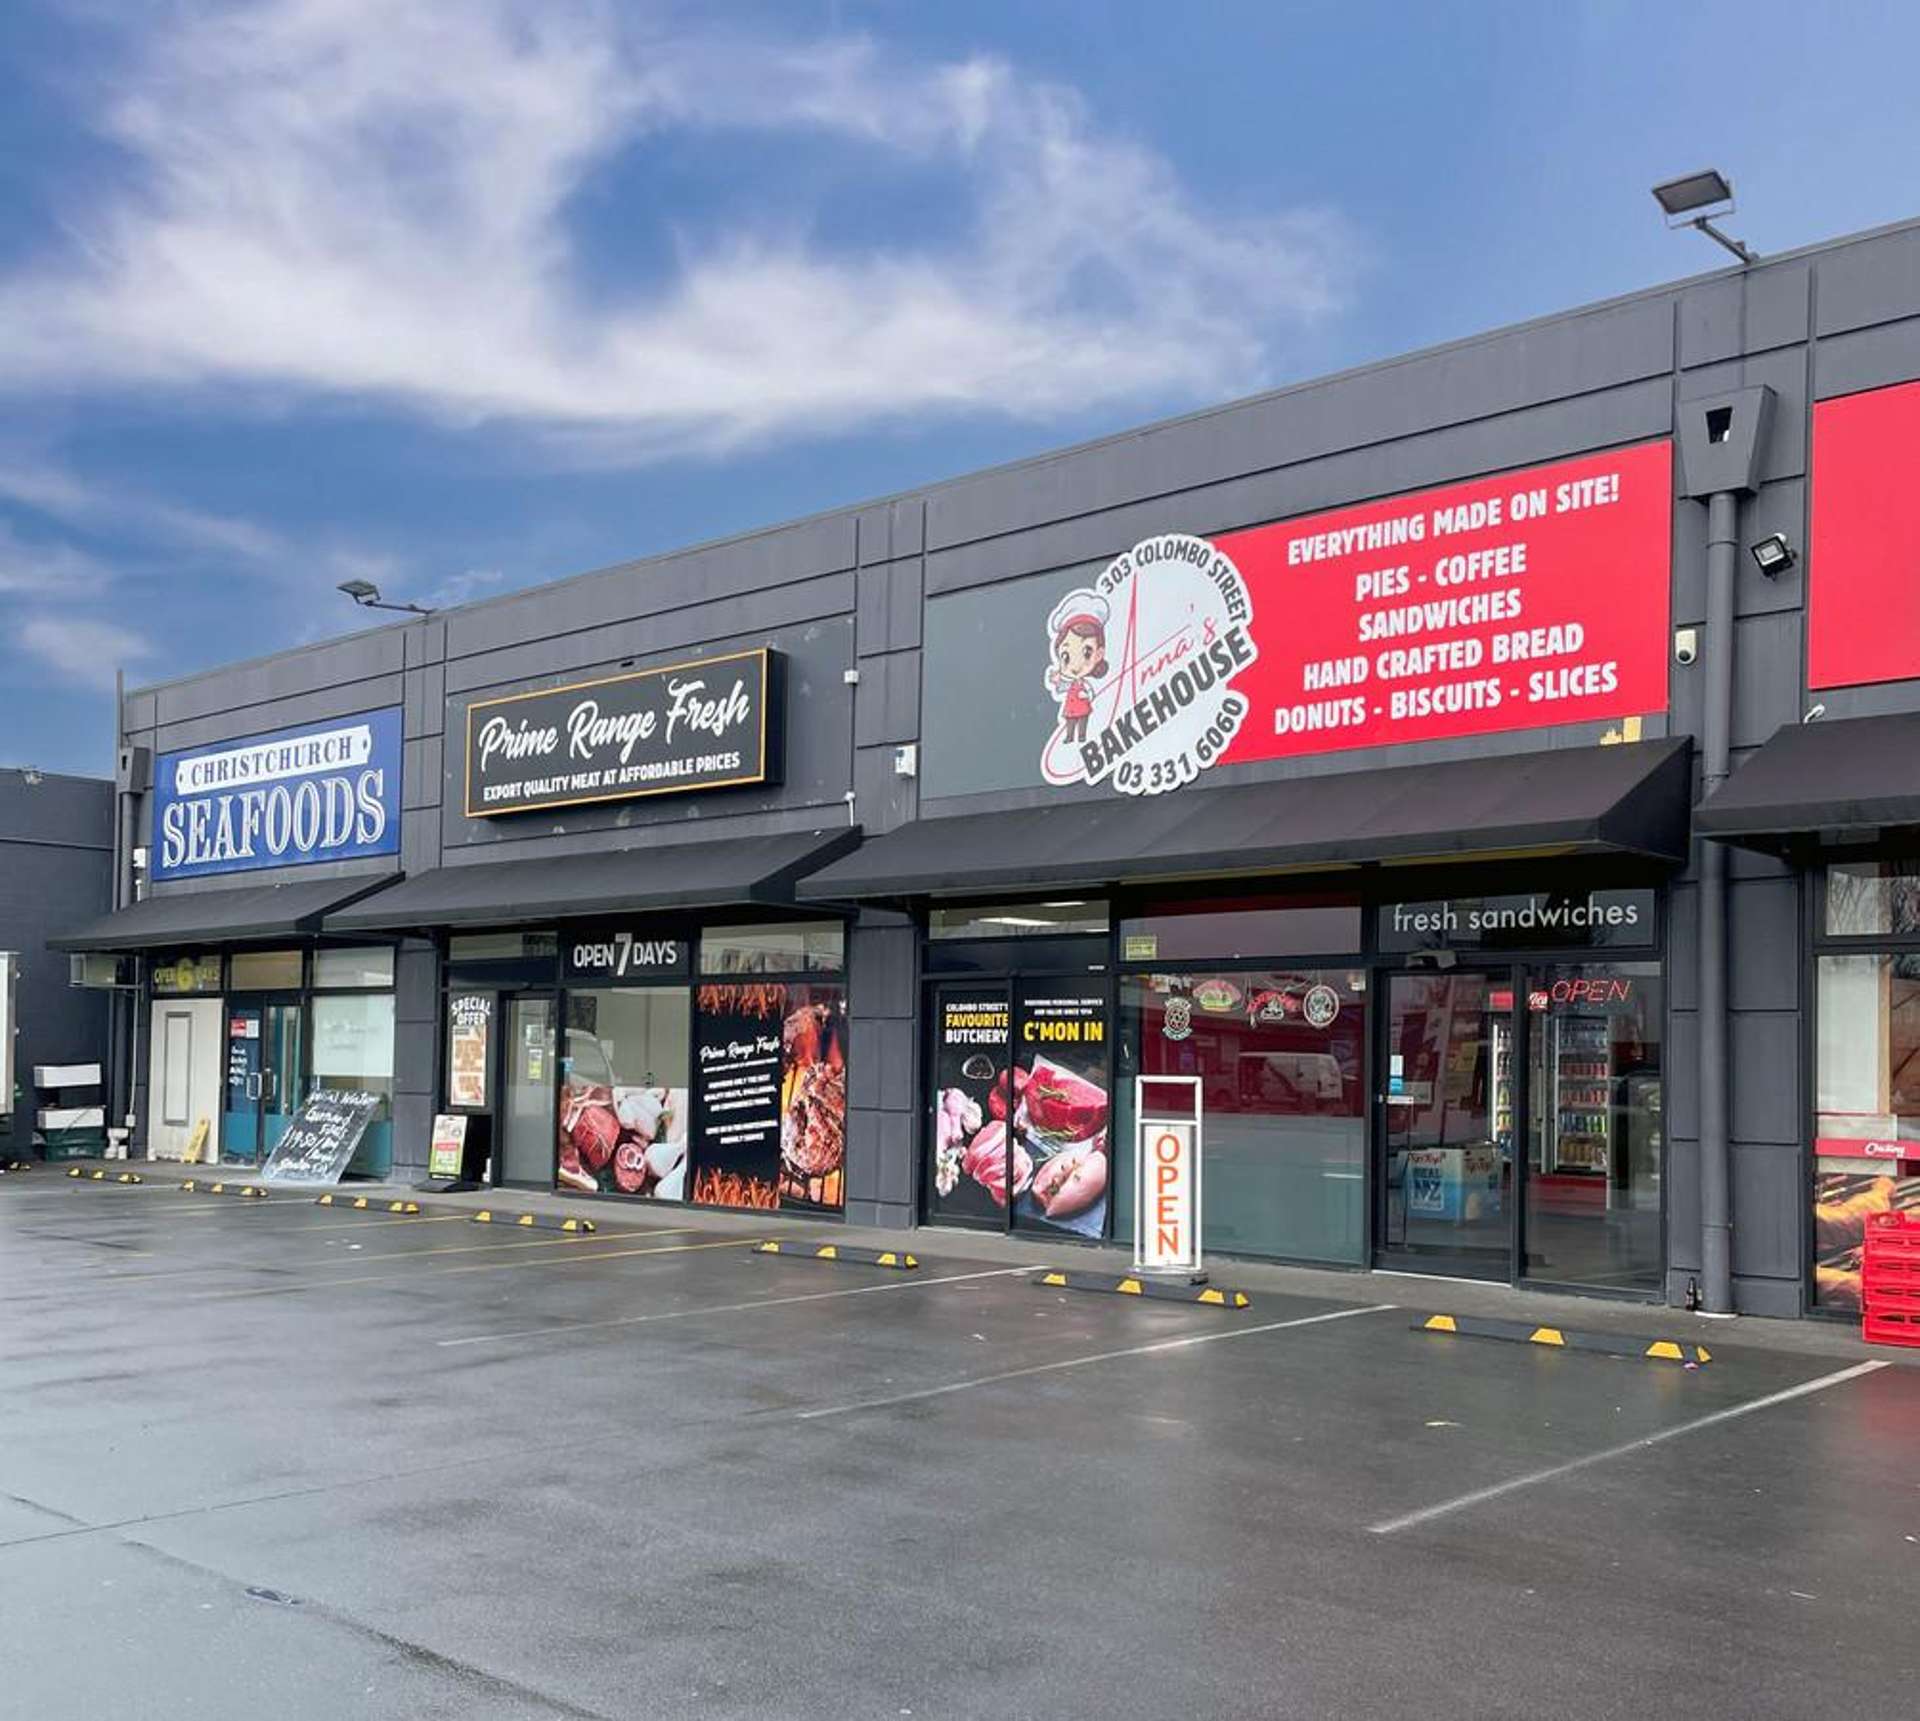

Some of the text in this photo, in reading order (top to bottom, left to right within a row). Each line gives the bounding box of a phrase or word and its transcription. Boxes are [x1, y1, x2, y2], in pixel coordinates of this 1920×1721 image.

[1287, 473, 1621, 566] EVERYTHING MADE ON SITE!
[1100, 540, 1248, 623] 303 COLOMBO STREET
[1356, 566, 1410, 602] PIES
[1435, 543, 1527, 587] COFFEE
[1358, 587, 1522, 642] SANDWICHES
[1070, 571, 1216, 750] Anna's
[1304, 622, 1584, 691] HAND CRAFTED BREAD
[479, 677, 750, 772] Prime Range Fresh
[1080, 626, 1252, 777] BAKEHOUSE
[1274, 695, 1366, 736] DONUTS
[1390, 677, 1502, 721] BISCUITS
[1528, 660, 1619, 702] SLICES
[191, 735, 352, 787] CHRISTCHURCH
[1118, 697, 1242, 788] 03 331 6060
[484, 752, 740, 801] EXPORT QUALITY MEAT AT AFFORDABLE PRICES
[162, 769, 384, 868] SEAFOODS
[1394, 898, 1638, 932] fresh sandwiches
[573, 933, 677, 976] OPEN 7 DAYS
[451, 997, 491, 1016] SPECIAL
[946, 1003, 977, 1012] COLOMBO
[1552, 980, 1632, 1002] OPEN
[457, 1012, 486, 1026] OFFER
[946, 1013, 1009, 1027] FAVOURITE
[946, 1029, 1009, 1044] BUTCHERY
[1024, 1021, 1103, 1041] C'MON IN
[700, 1036, 780, 1063] Prime Range Fresh
[1156, 1133, 1180, 1257] OPEN
